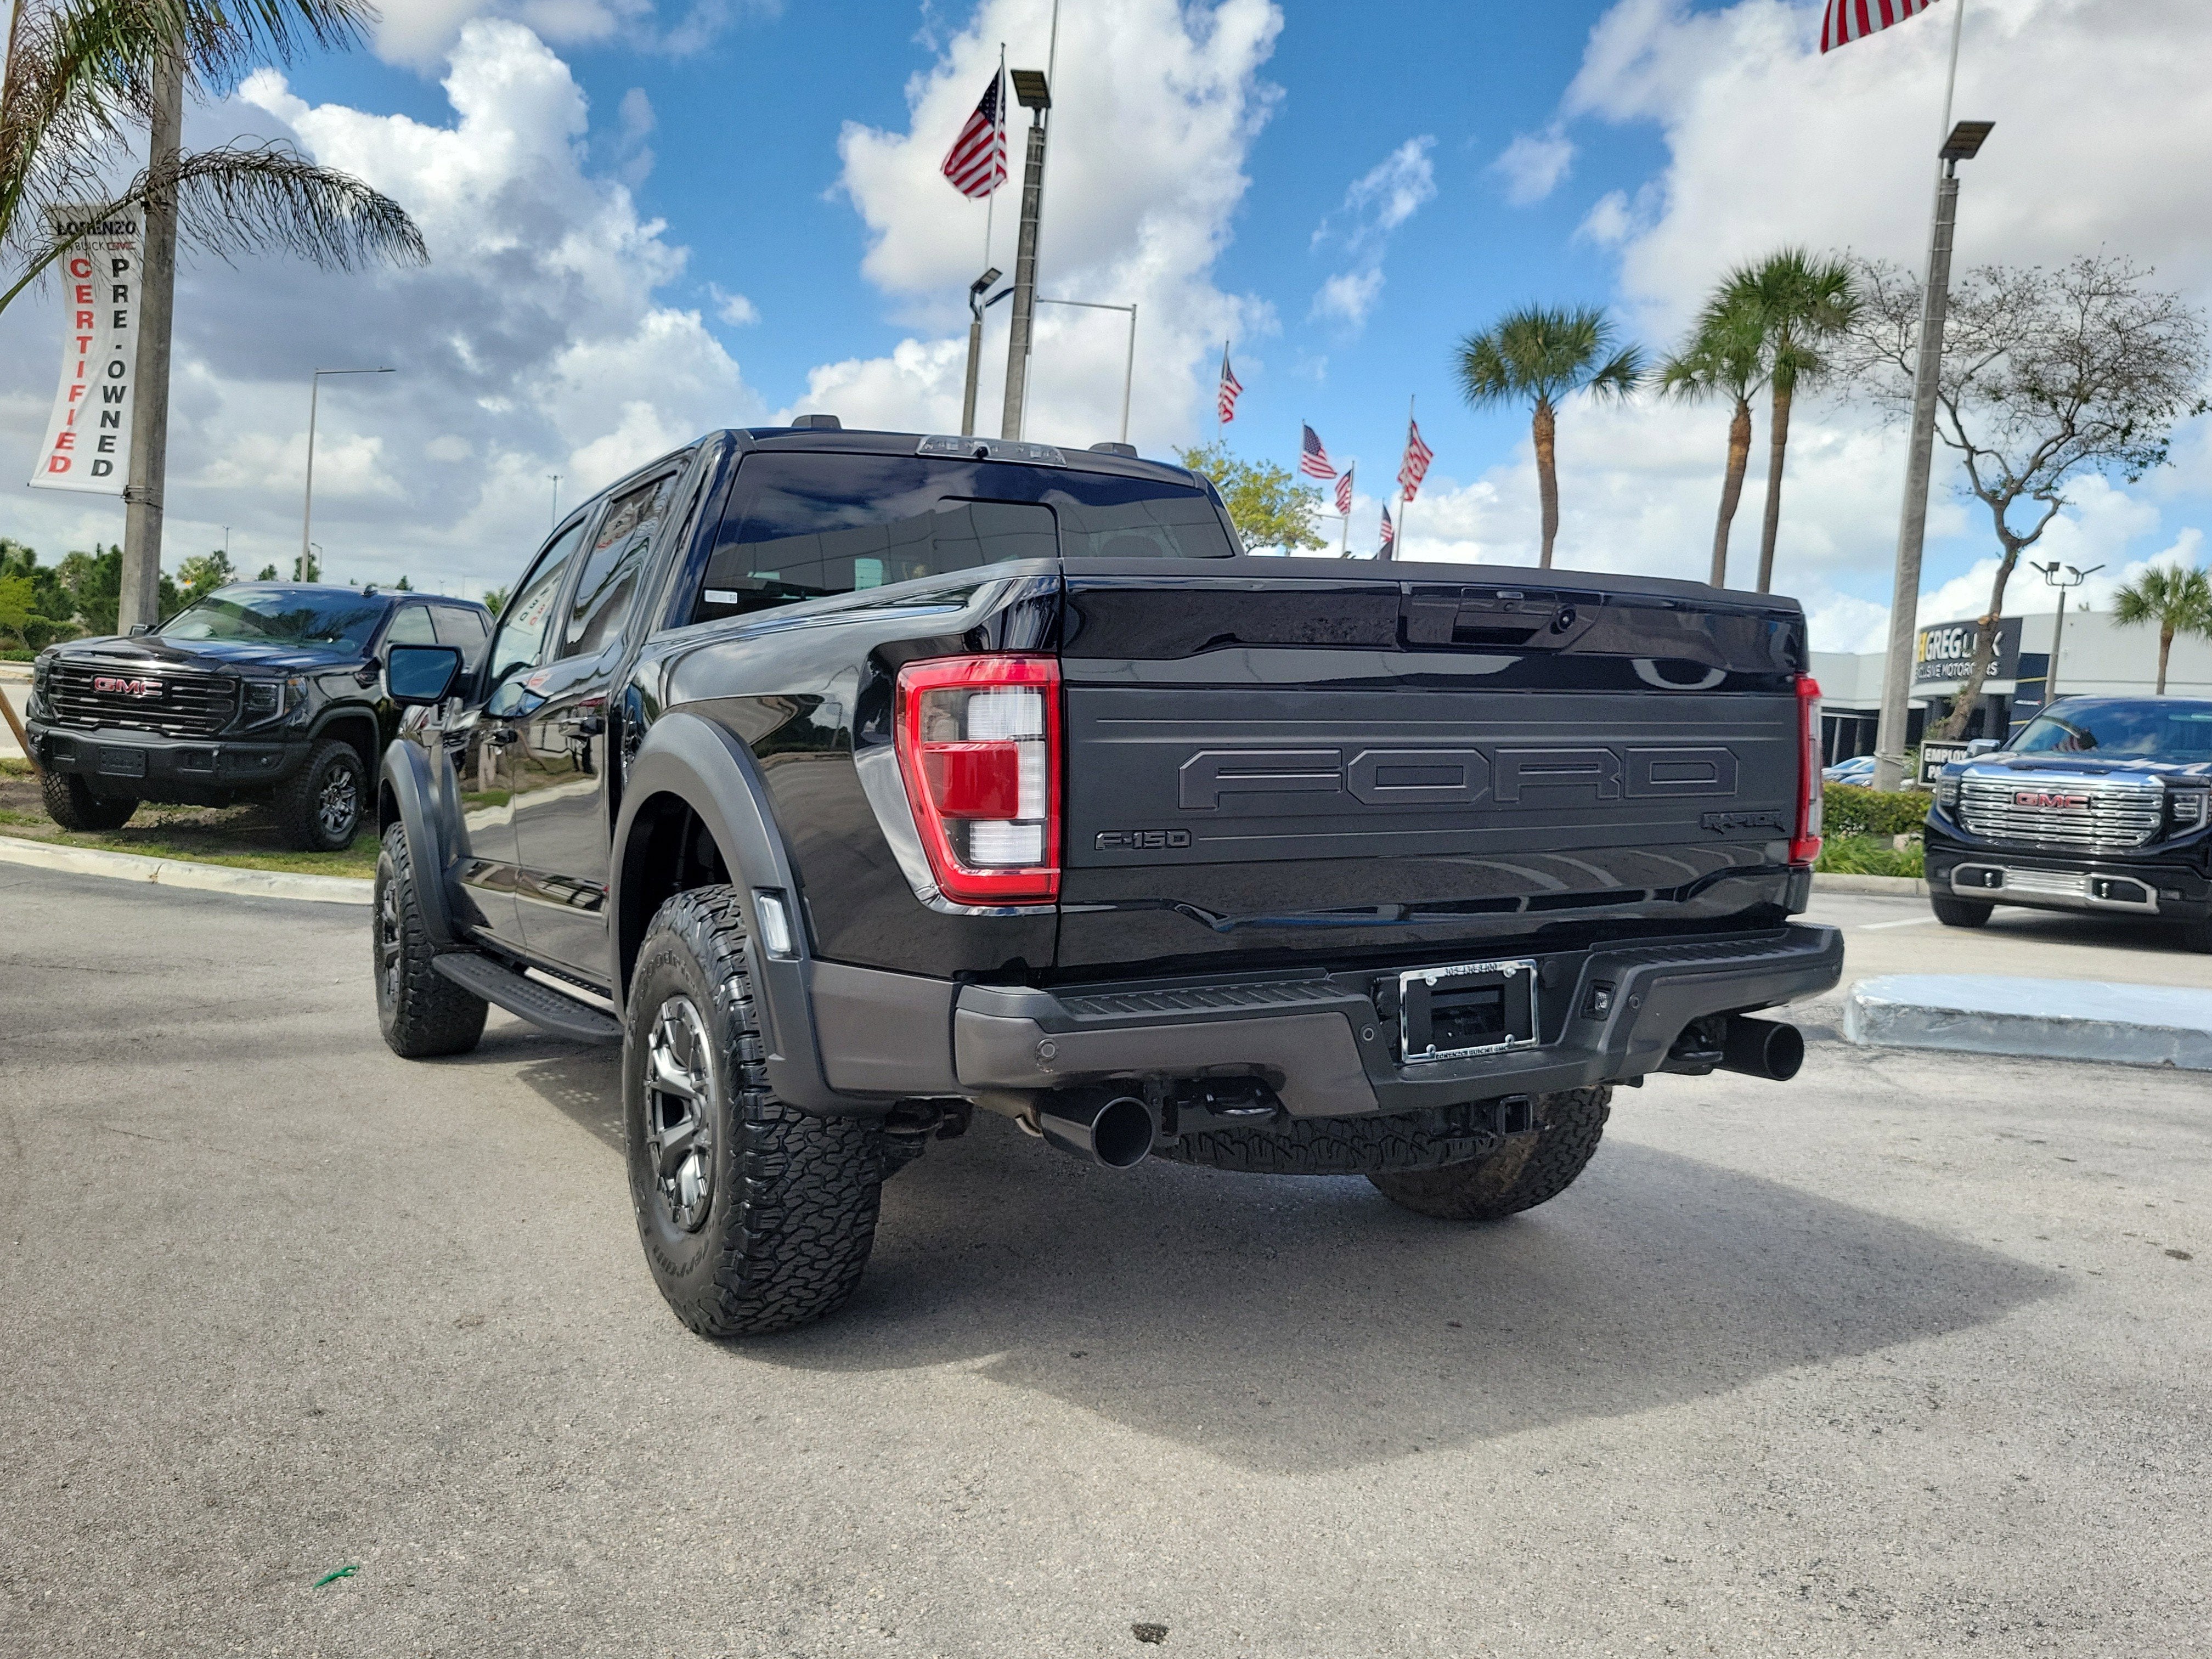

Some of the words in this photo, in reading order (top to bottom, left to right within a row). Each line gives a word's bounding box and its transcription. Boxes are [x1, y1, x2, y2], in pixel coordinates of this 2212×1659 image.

[75, 241, 104, 251] BUICK
[48, 258, 92, 475] CERTIFIED
[91, 258, 130, 477] PRE-OWNED
[94, 677, 163, 696] GMC
[1178, 747, 1739, 810] FORD
[2016, 793, 2089, 809] GMC
[1095, 829, 1192, 850] F-150
